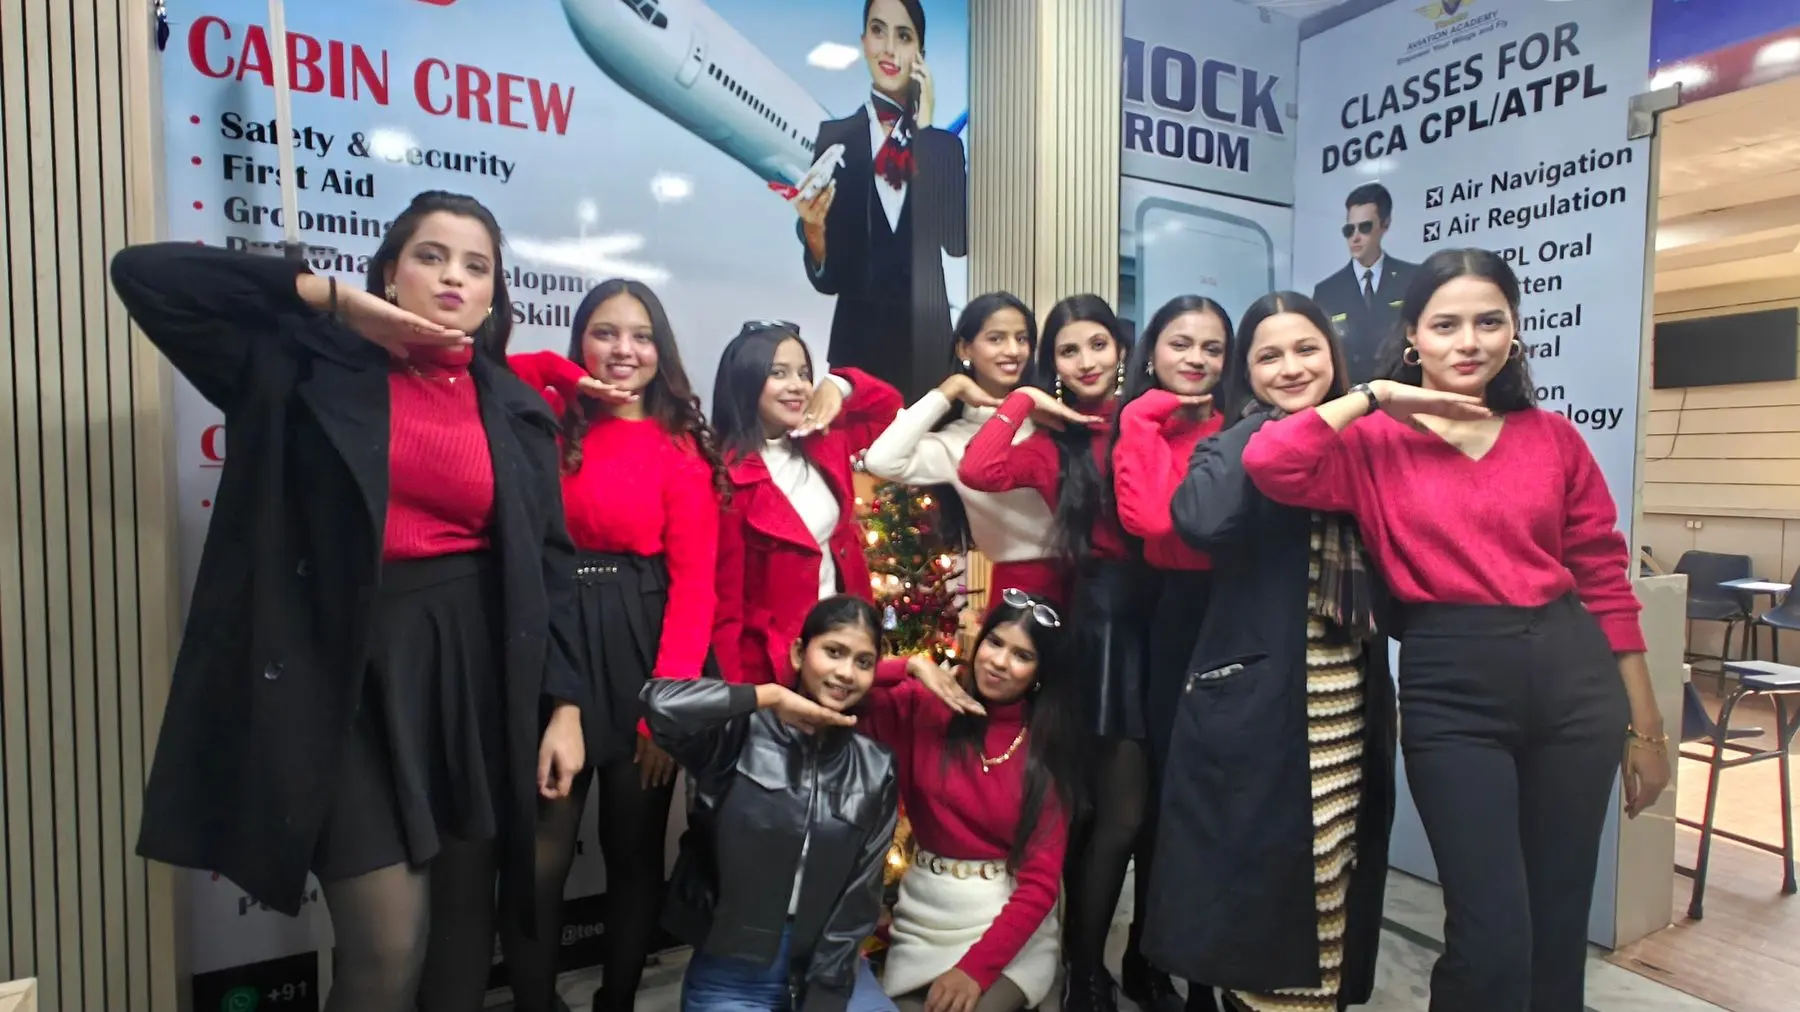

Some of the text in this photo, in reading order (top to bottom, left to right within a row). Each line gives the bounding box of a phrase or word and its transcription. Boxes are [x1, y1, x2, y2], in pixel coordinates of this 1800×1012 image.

[1451, 9, 1498, 33] ACADEMY
[188, 15, 575, 136] CABIN CREW
[1341, 21, 1580, 129] CLASSES FOR
[1125, 111, 1249, 172] ROOM
[1322, 64, 1607, 174] DGCA CPL/ATPL
[220, 111, 515, 184] Safety & ecurity
[321, 169, 374, 198] Aid
[1450, 147, 1632, 203] Air Navigation
[1448, 186, 1626, 236] Air Regulation
[1538, 233, 1592, 262] Oral
[1518, 304, 1581, 331] nical
[1555, 404, 1623, 430] logy
[267, 979, 307, 1001] +91
